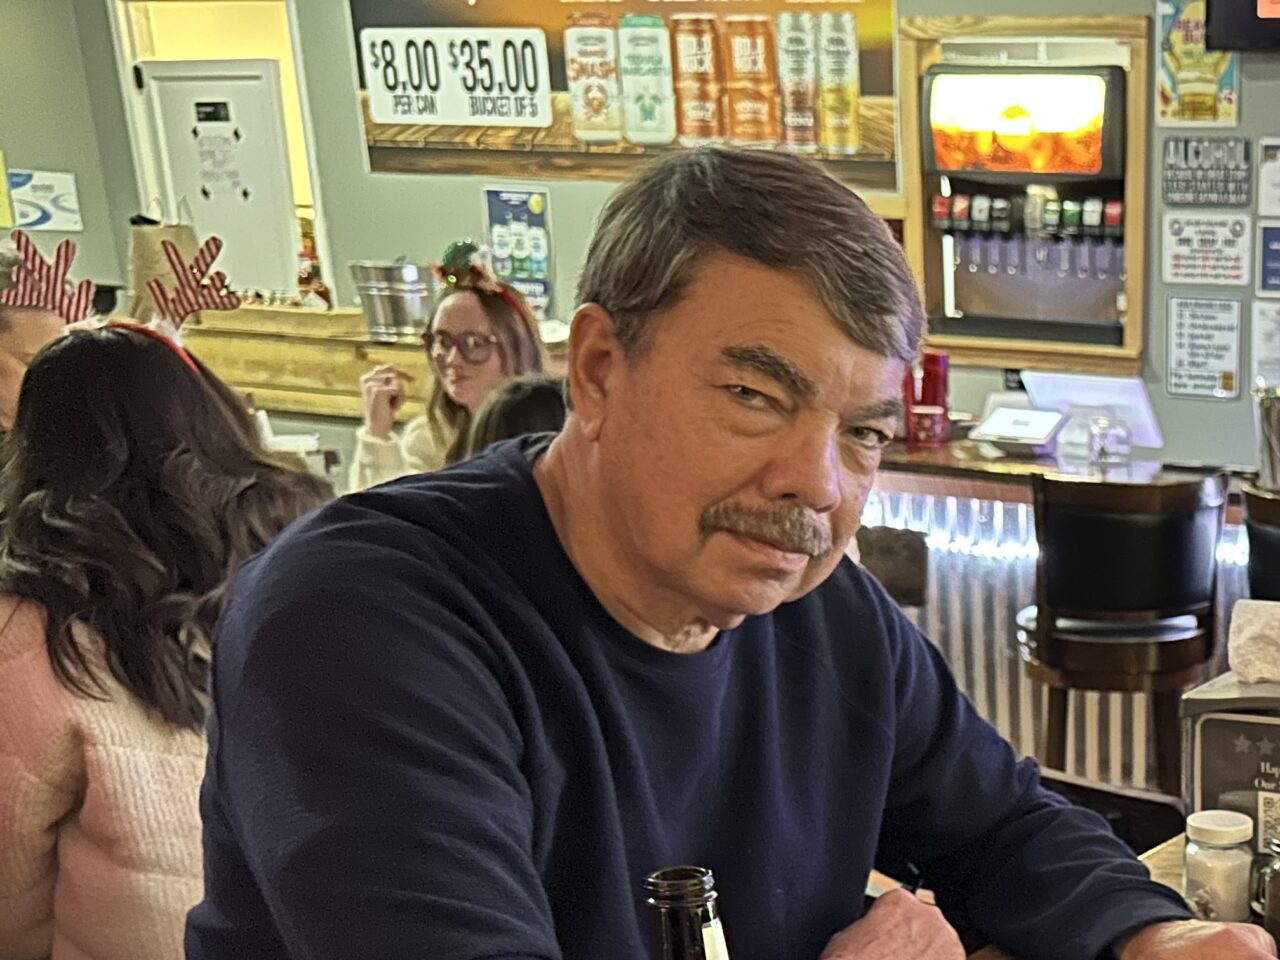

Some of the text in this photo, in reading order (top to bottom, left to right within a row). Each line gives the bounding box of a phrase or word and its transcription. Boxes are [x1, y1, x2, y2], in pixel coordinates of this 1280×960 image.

[370, 39, 539, 93] $8.00 $35.00
[1254, 777, 1276, 790] Our
